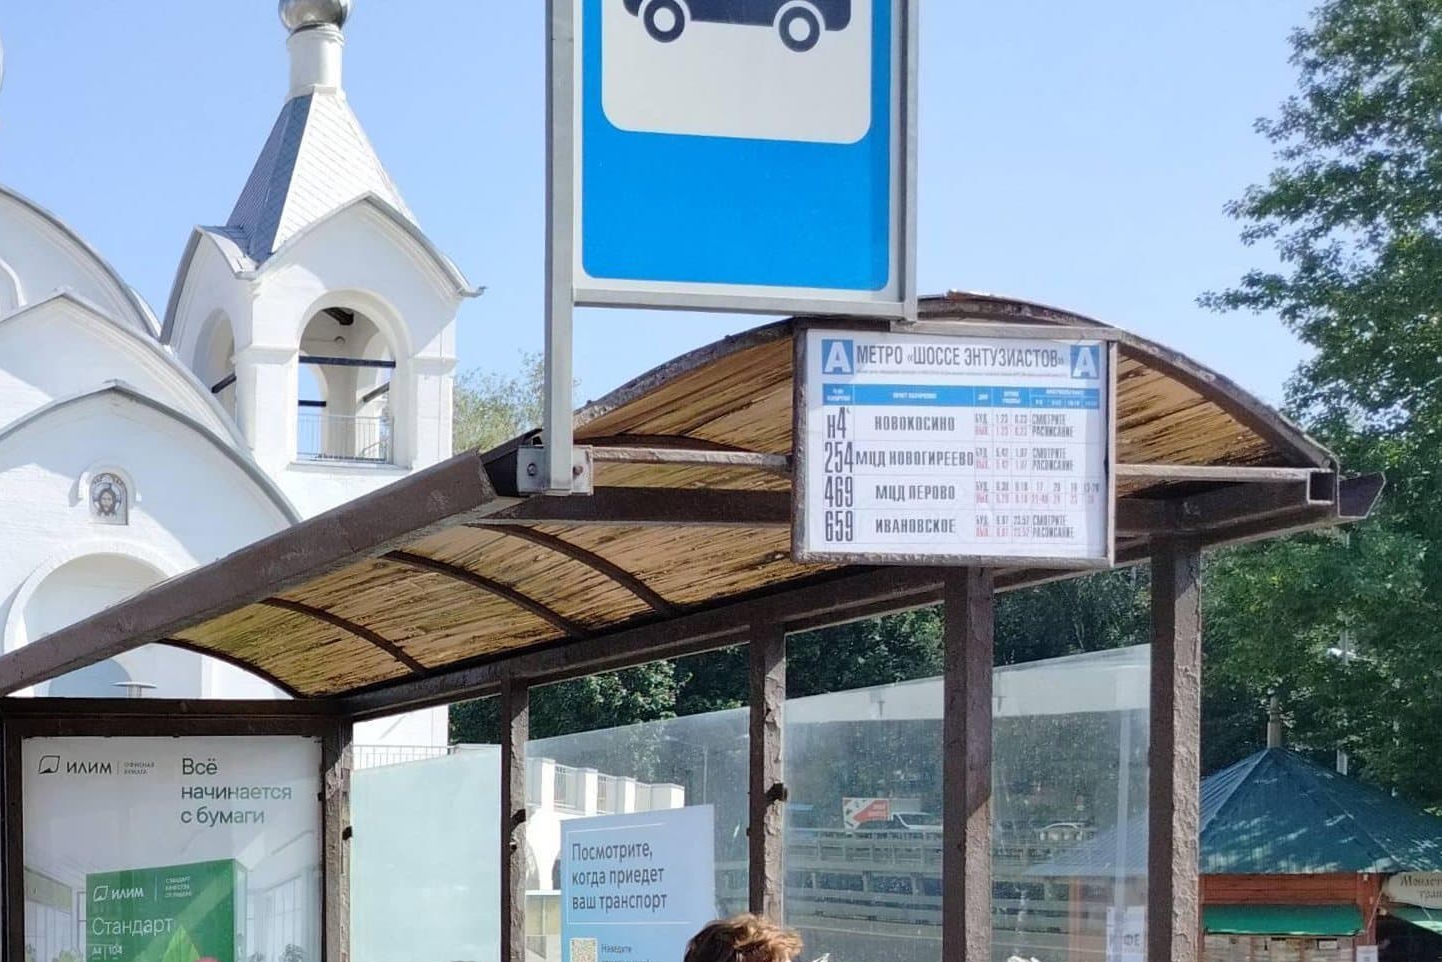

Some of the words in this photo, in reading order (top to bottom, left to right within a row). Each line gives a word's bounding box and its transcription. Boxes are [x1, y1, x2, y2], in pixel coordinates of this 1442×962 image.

[824, 341, 851, 374] А
[857, 345, 903, 366] МЕТРО
[908, 346, 960, 366] «ШОССЕ
[963, 348, 1065, 369] ЭНТУЗИАСТОВ»
[1072, 347, 1098, 378] А
[875, 416, 956, 431] НОВОКОСИНО
[824, 441, 854, 473] 254
[856, 450, 886, 467] МЦД
[889, 451, 974, 466] НОВОГИРЕЕВО
[824, 476, 854, 508] 469
[875, 485, 905, 502] МЦД
[908, 485, 956, 500] ПЕРОВО
[824, 510, 855, 542] 659
[875, 518, 956, 534] ИВАНОВСКОЕ
[66, 761, 112, 774] ИЛИМ
[182, 757, 218, 775] Всё
[181, 786, 292, 800] начинается
[180, 810, 192, 824] с
[196, 805, 265, 827] бумаги
[572, 841, 653, 862] Посмотрите,
[572, 872, 606, 888] когда
[609, 867, 665, 888] приедет
[111, 887, 144, 900] ИЛИМ
[572, 895, 596, 910] ваш
[599, 893, 667, 913] транспорт
[92, 917, 174, 937] Стандарт
